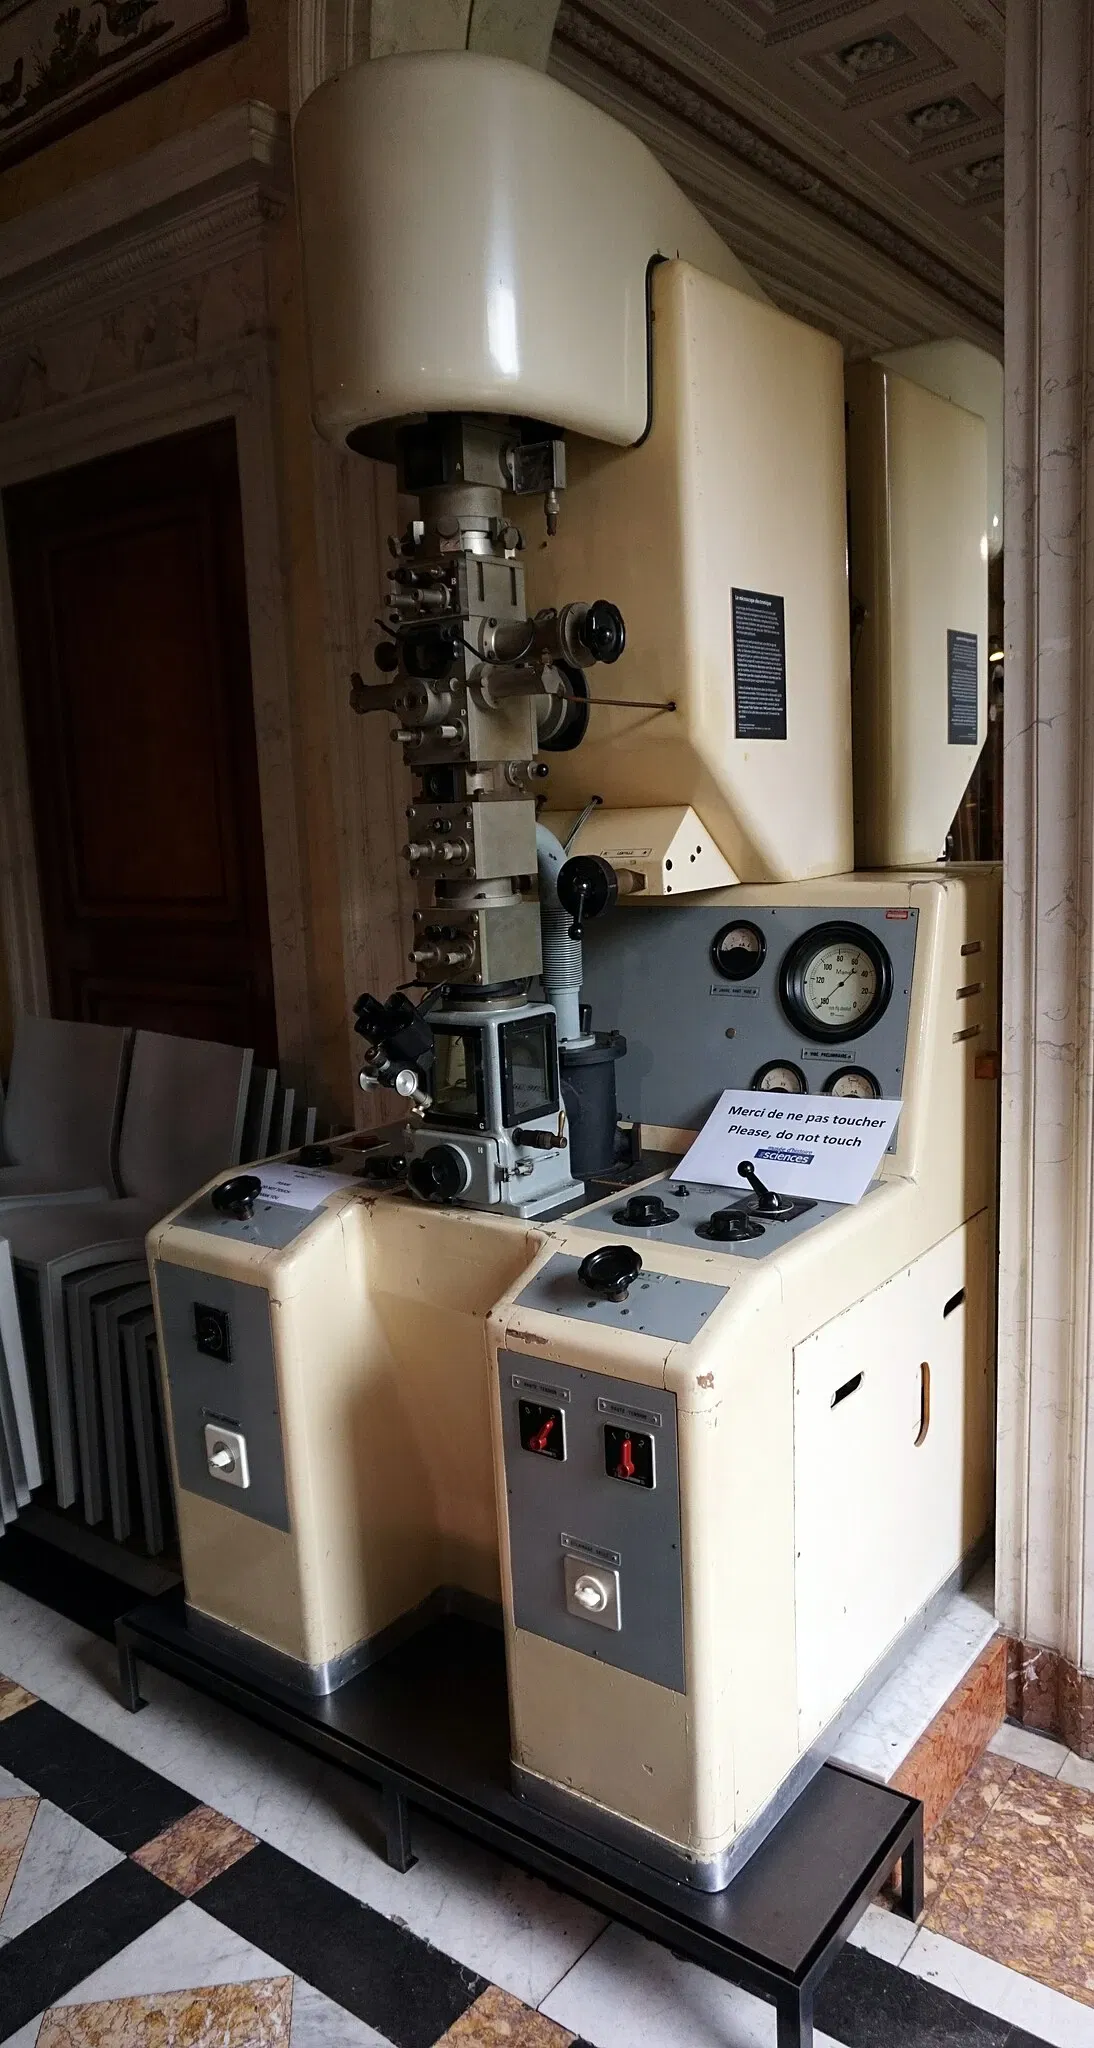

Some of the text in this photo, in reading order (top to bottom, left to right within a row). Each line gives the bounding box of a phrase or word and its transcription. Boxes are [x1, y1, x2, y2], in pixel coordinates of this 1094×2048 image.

[455, 462, 461, 471] A
[451, 577, 457, 585] B
[460, 708, 467, 716] D
[466, 821, 472, 829] E
[728, 1106, 886, 1128] Merci de ne pas toucher
[728, 1125, 862, 1147] Please, do not touch
[763, 1151, 810, 1163] sciences
[624, 1431, 630, 1440] 0
[638, 1439, 645, 1448] 2
